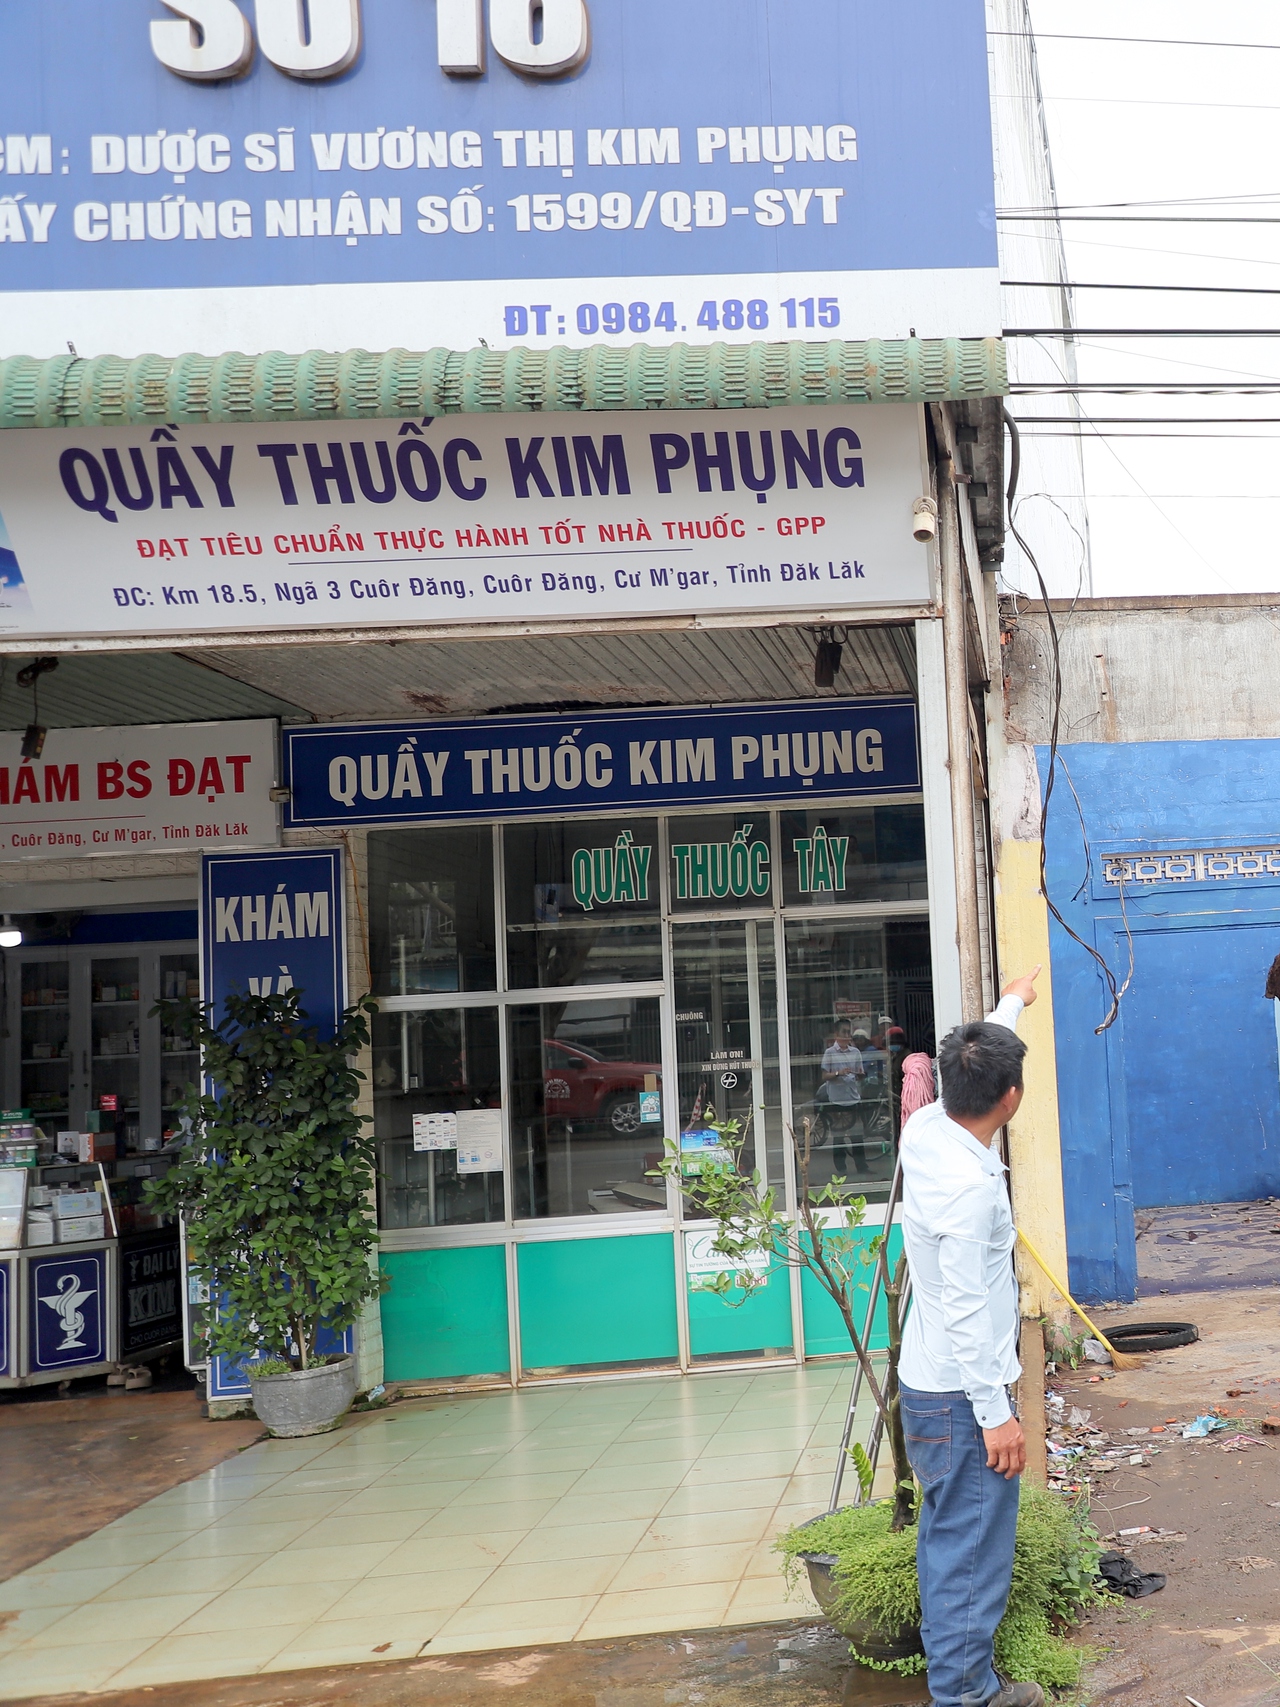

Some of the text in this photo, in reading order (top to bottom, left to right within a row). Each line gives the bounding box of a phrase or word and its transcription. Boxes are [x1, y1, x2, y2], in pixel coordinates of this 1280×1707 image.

[0, 125, 858, 184] M: DƯỢC SĨ VƯƠNG THỊ KIM PHỤNG
[74, 194, 252, 242] CHỨNG
[266, 191, 401, 246] NHẬN
[417, 184, 495, 234] SỐ:
[507, 187, 847, 232] 1599/QĐ-SYT
[780, 298, 840, 328] 115
[59, 416, 865, 523] QUẦY THUỐC KIM PHỤNG
[137, 538, 190, 561] ĐẠT
[200, 531, 263, 556] TIÊU
[274, 524, 365, 553] CHUẨN
[374, 527, 444, 553] THỰC
[455, 519, 529, 548] HÀNH
[539, 518, 586, 545] TỐT
[599, 518, 652, 542] NHÀ
[662, 512, 746, 540] THUỐC
[777, 516, 826, 536] GPP
[113, 587, 153, 607] ĐC:
[162, 585, 199, 606] Km
[207, 583, 267, 606] 18.5,
[275, 580, 316, 606] Ngã
[327, 580, 341, 601] 3
[351, 577, 400, 599] Cuôr
[409, 576, 474, 600] Đăng,
[483, 572, 532, 594] Cuôr
[542, 571, 605, 594] Đăng,
[614, 568, 641, 590] Cư
[726, 563, 771, 584] Tỉnh
[780, 561, 819, 582] Đăk
[828, 560, 865, 581] Lăk
[97, 759, 152, 800] BS
[167, 755, 251, 803] ĐẠT
[328, 727, 885, 807] QUẦY THUỐC KIM PHỤNG
[11, 833, 42, 848] Cuôr
[48, 831, 86, 847] Đăng,
[93, 828, 110, 843] Cư
[162, 823, 190, 840] Tỉnh
[195, 823, 220, 838] Đăk
[225, 822, 249, 836] Lăk
[571, 823, 850, 911] QUẦY THUỐC TÂY
[215, 883, 330, 943] KHÁM
[128, 1279, 176, 1323] KIM
